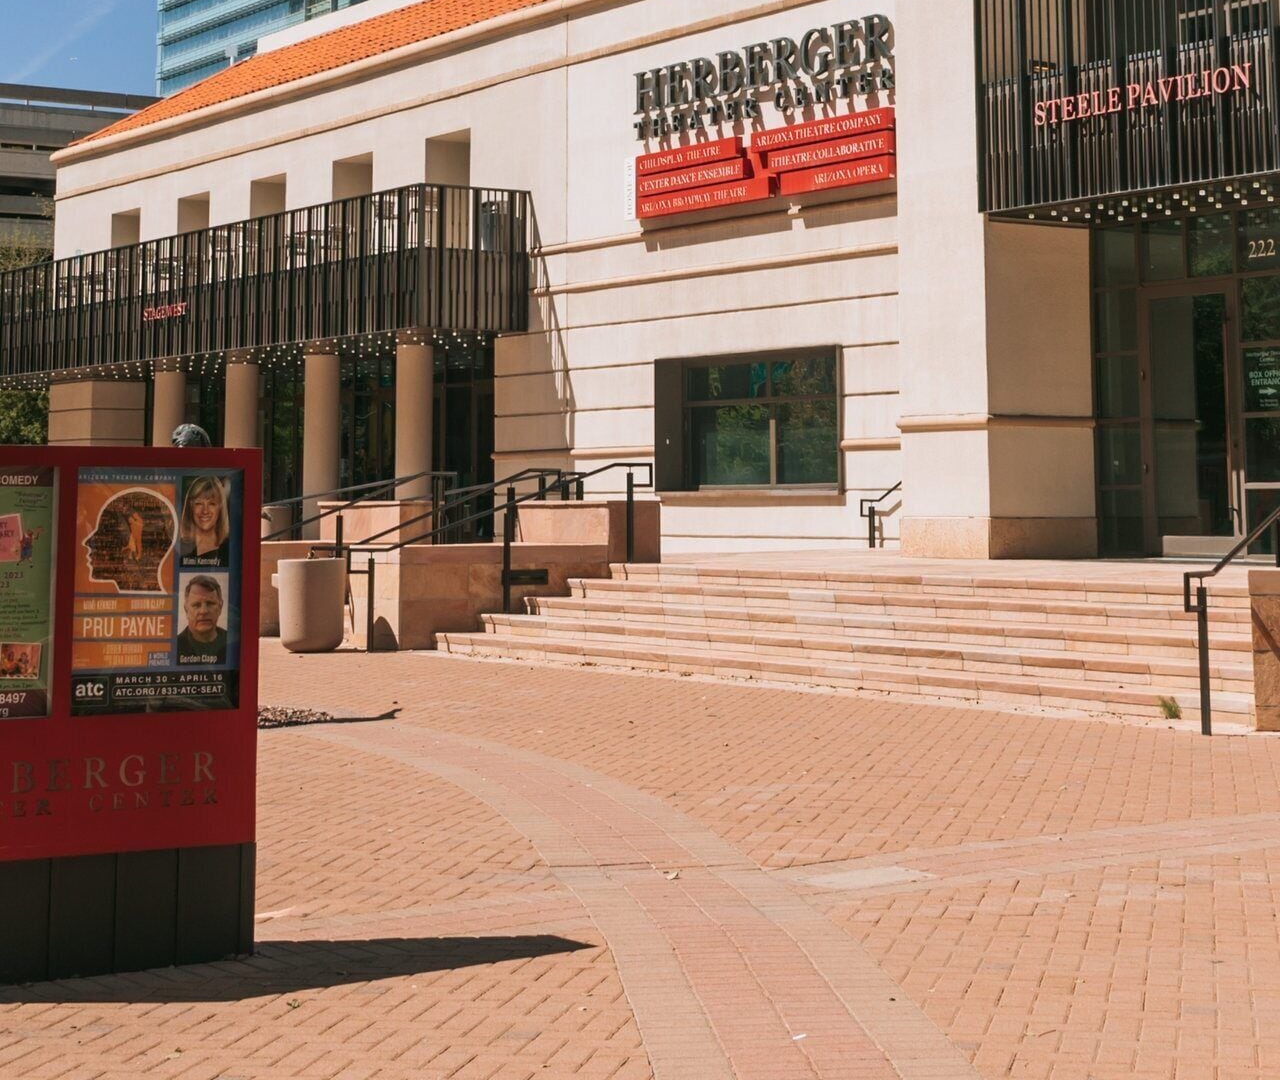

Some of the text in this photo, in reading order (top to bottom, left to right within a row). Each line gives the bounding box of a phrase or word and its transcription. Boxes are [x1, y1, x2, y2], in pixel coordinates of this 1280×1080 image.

[633, 14, 894, 115] HERBERGER
[633, 68, 895, 141] THEATER CENTER
[1034, 63, 1252, 126] STEELE PAVILION
[755, 114, 883, 148] ARIZONA THEATRE COMPANY
[639, 146, 721, 170] CHILDSPLAY THEATRE
[813, 138, 885, 160] COLLABORATIVE
[639, 164, 741, 192] CENTER DANCE ENSEMBLE
[813, 163, 883, 185] ARIZONA OPERA
[639, 186, 748, 213] ARIZONA BROADWAY THEATRE
[1248, 239, 1276, 259] 222
[143, 302, 187, 321] STAGE WEST
[1249, 371, 1264, 379] BOX
[183, 556, 221, 567] Mimi Kennedy
[4, 571, 24, 580] 2023
[82, 615, 166, 638] PRU PAYNE
[179, 654, 218, 665] Gordon Clapp
[75, 683, 104, 697] atc
[115, 675, 152, 684] MARCH
[156, 675, 168, 683] 30
[180, 674, 209, 682] APRIL
[88, 786, 219, 813] CENTER
